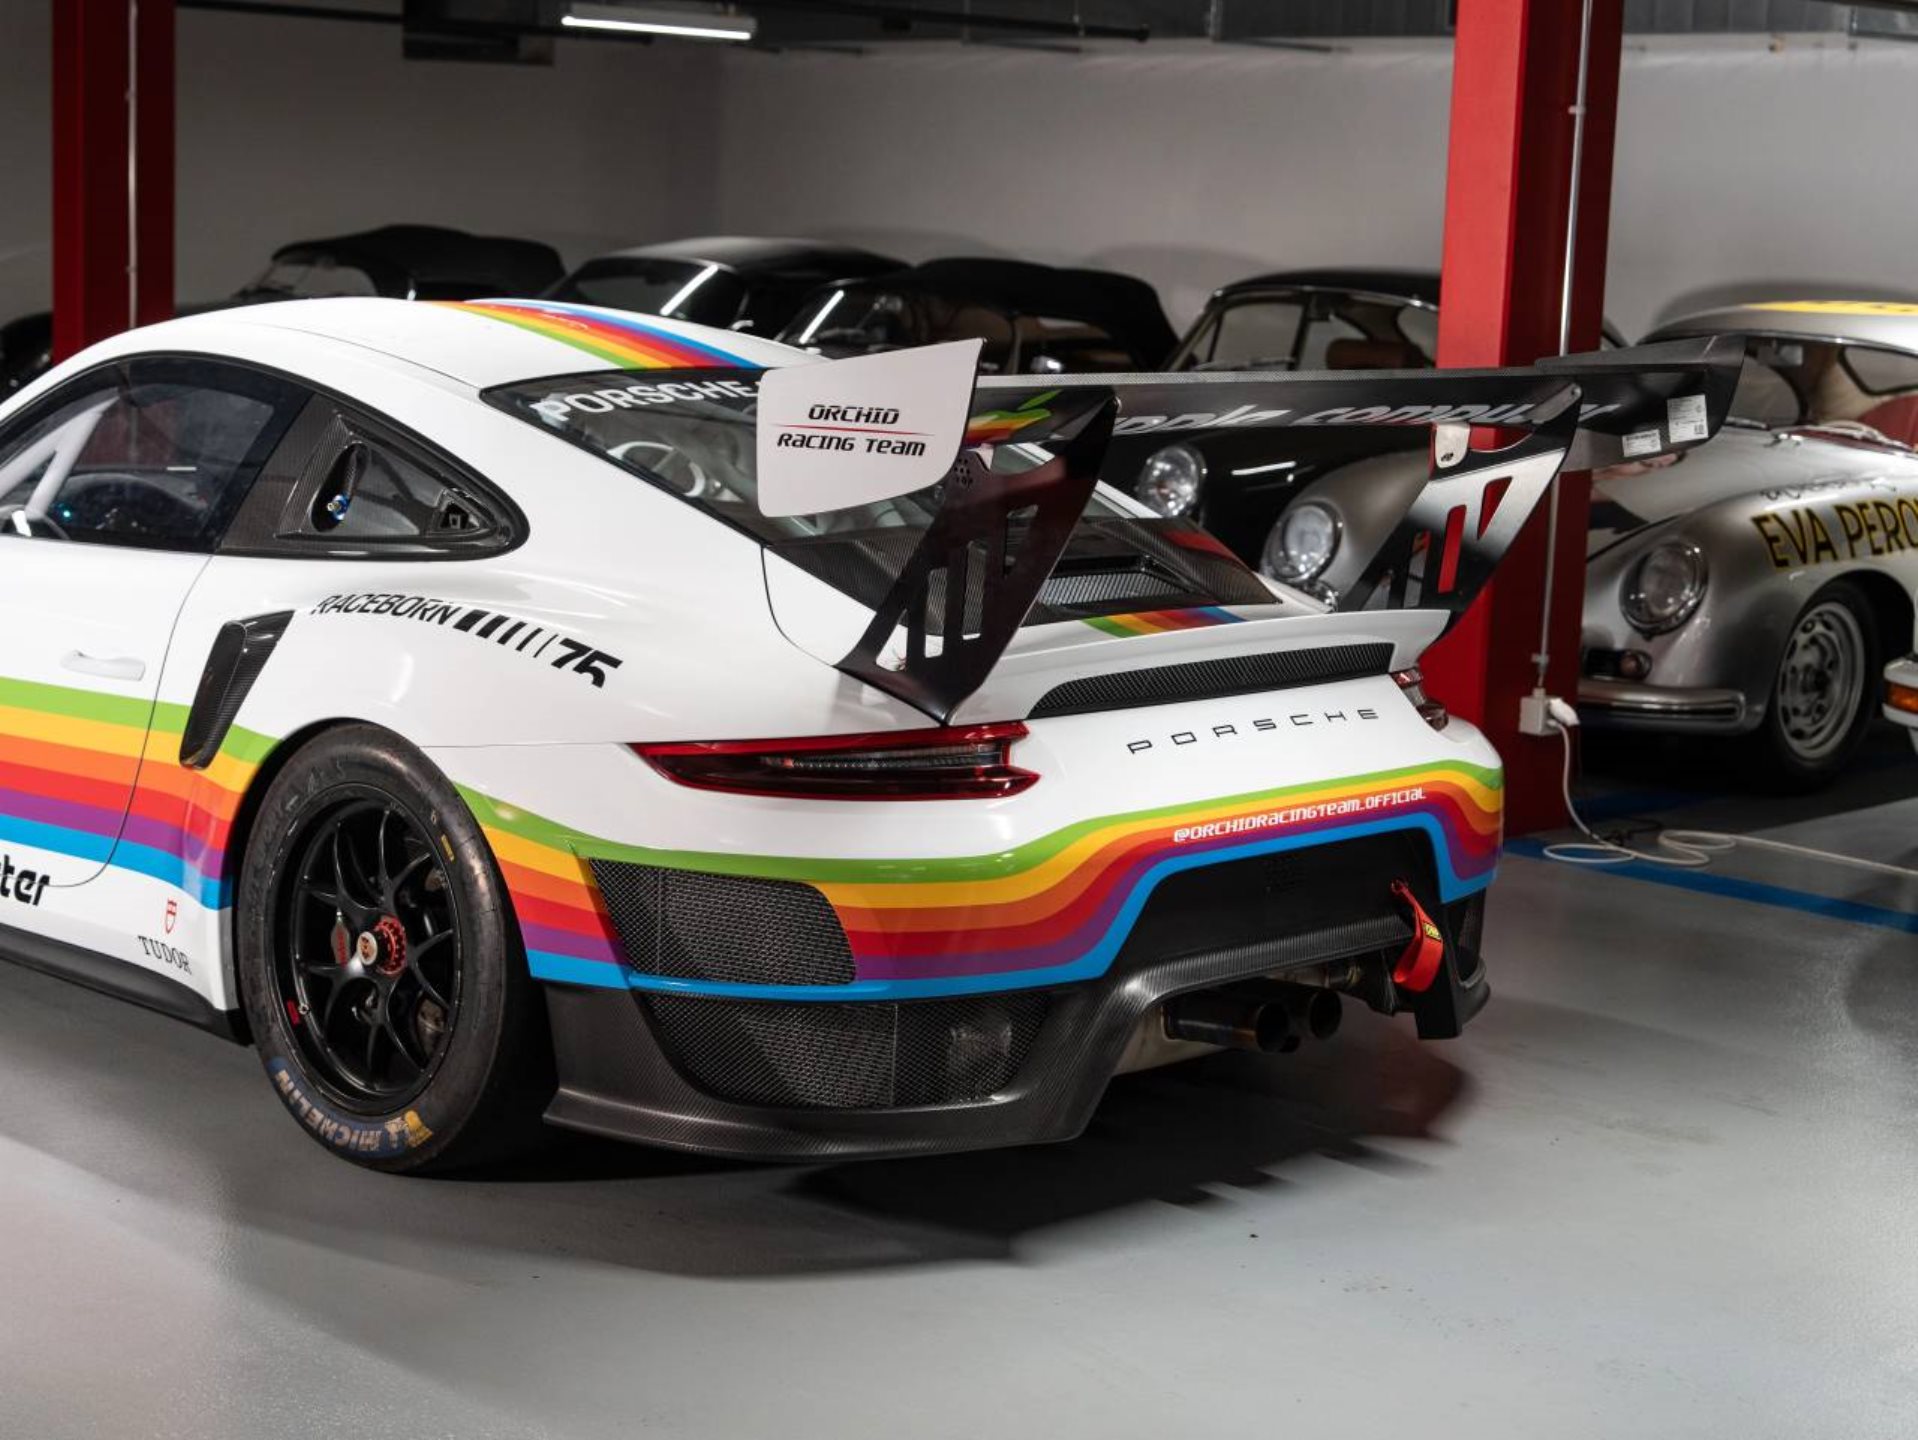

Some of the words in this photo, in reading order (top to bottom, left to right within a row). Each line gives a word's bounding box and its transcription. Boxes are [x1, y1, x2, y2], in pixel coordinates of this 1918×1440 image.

[529, 381, 757, 421] PORSCHE
[808, 404, 900, 424] ORCHID
[1113, 404, 1292, 435] pple
[1751, 507, 1839, 568] EVA
[1833, 497, 1918, 559] PERO
[310, 593, 462, 625] RACEBORN
[551, 637, 624, 688] 75
[1127, 708, 1379, 754] PORSCHE
[0, 854, 50, 906] ter
[138, 935, 192, 975] TUDOR
[275, 1068, 383, 1152] MICHELIN
